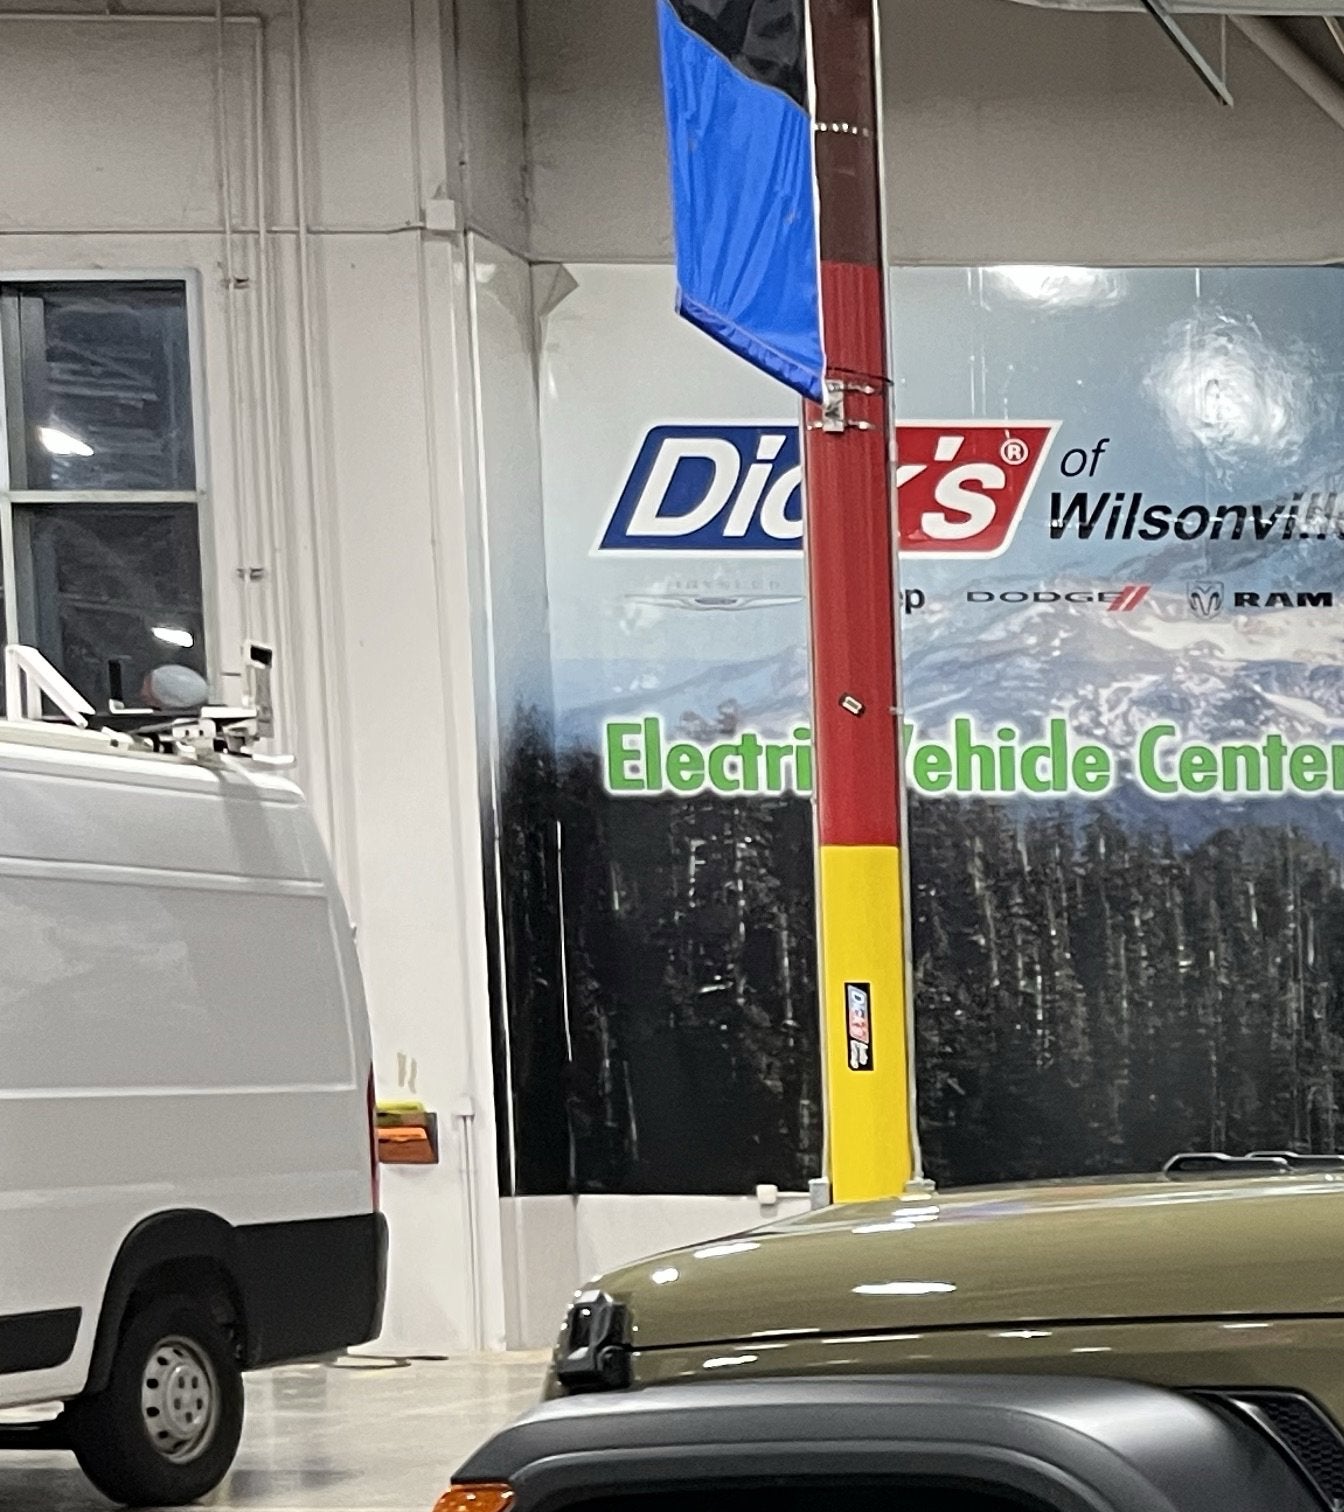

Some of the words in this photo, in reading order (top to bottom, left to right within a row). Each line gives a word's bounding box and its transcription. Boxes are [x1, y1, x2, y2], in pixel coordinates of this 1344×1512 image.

[1060, 438, 1110, 477] of
[966, 591, 1124, 604] DODGE
[1233, 591, 1334, 608] RAM
[606, 717, 814, 792] Electri
